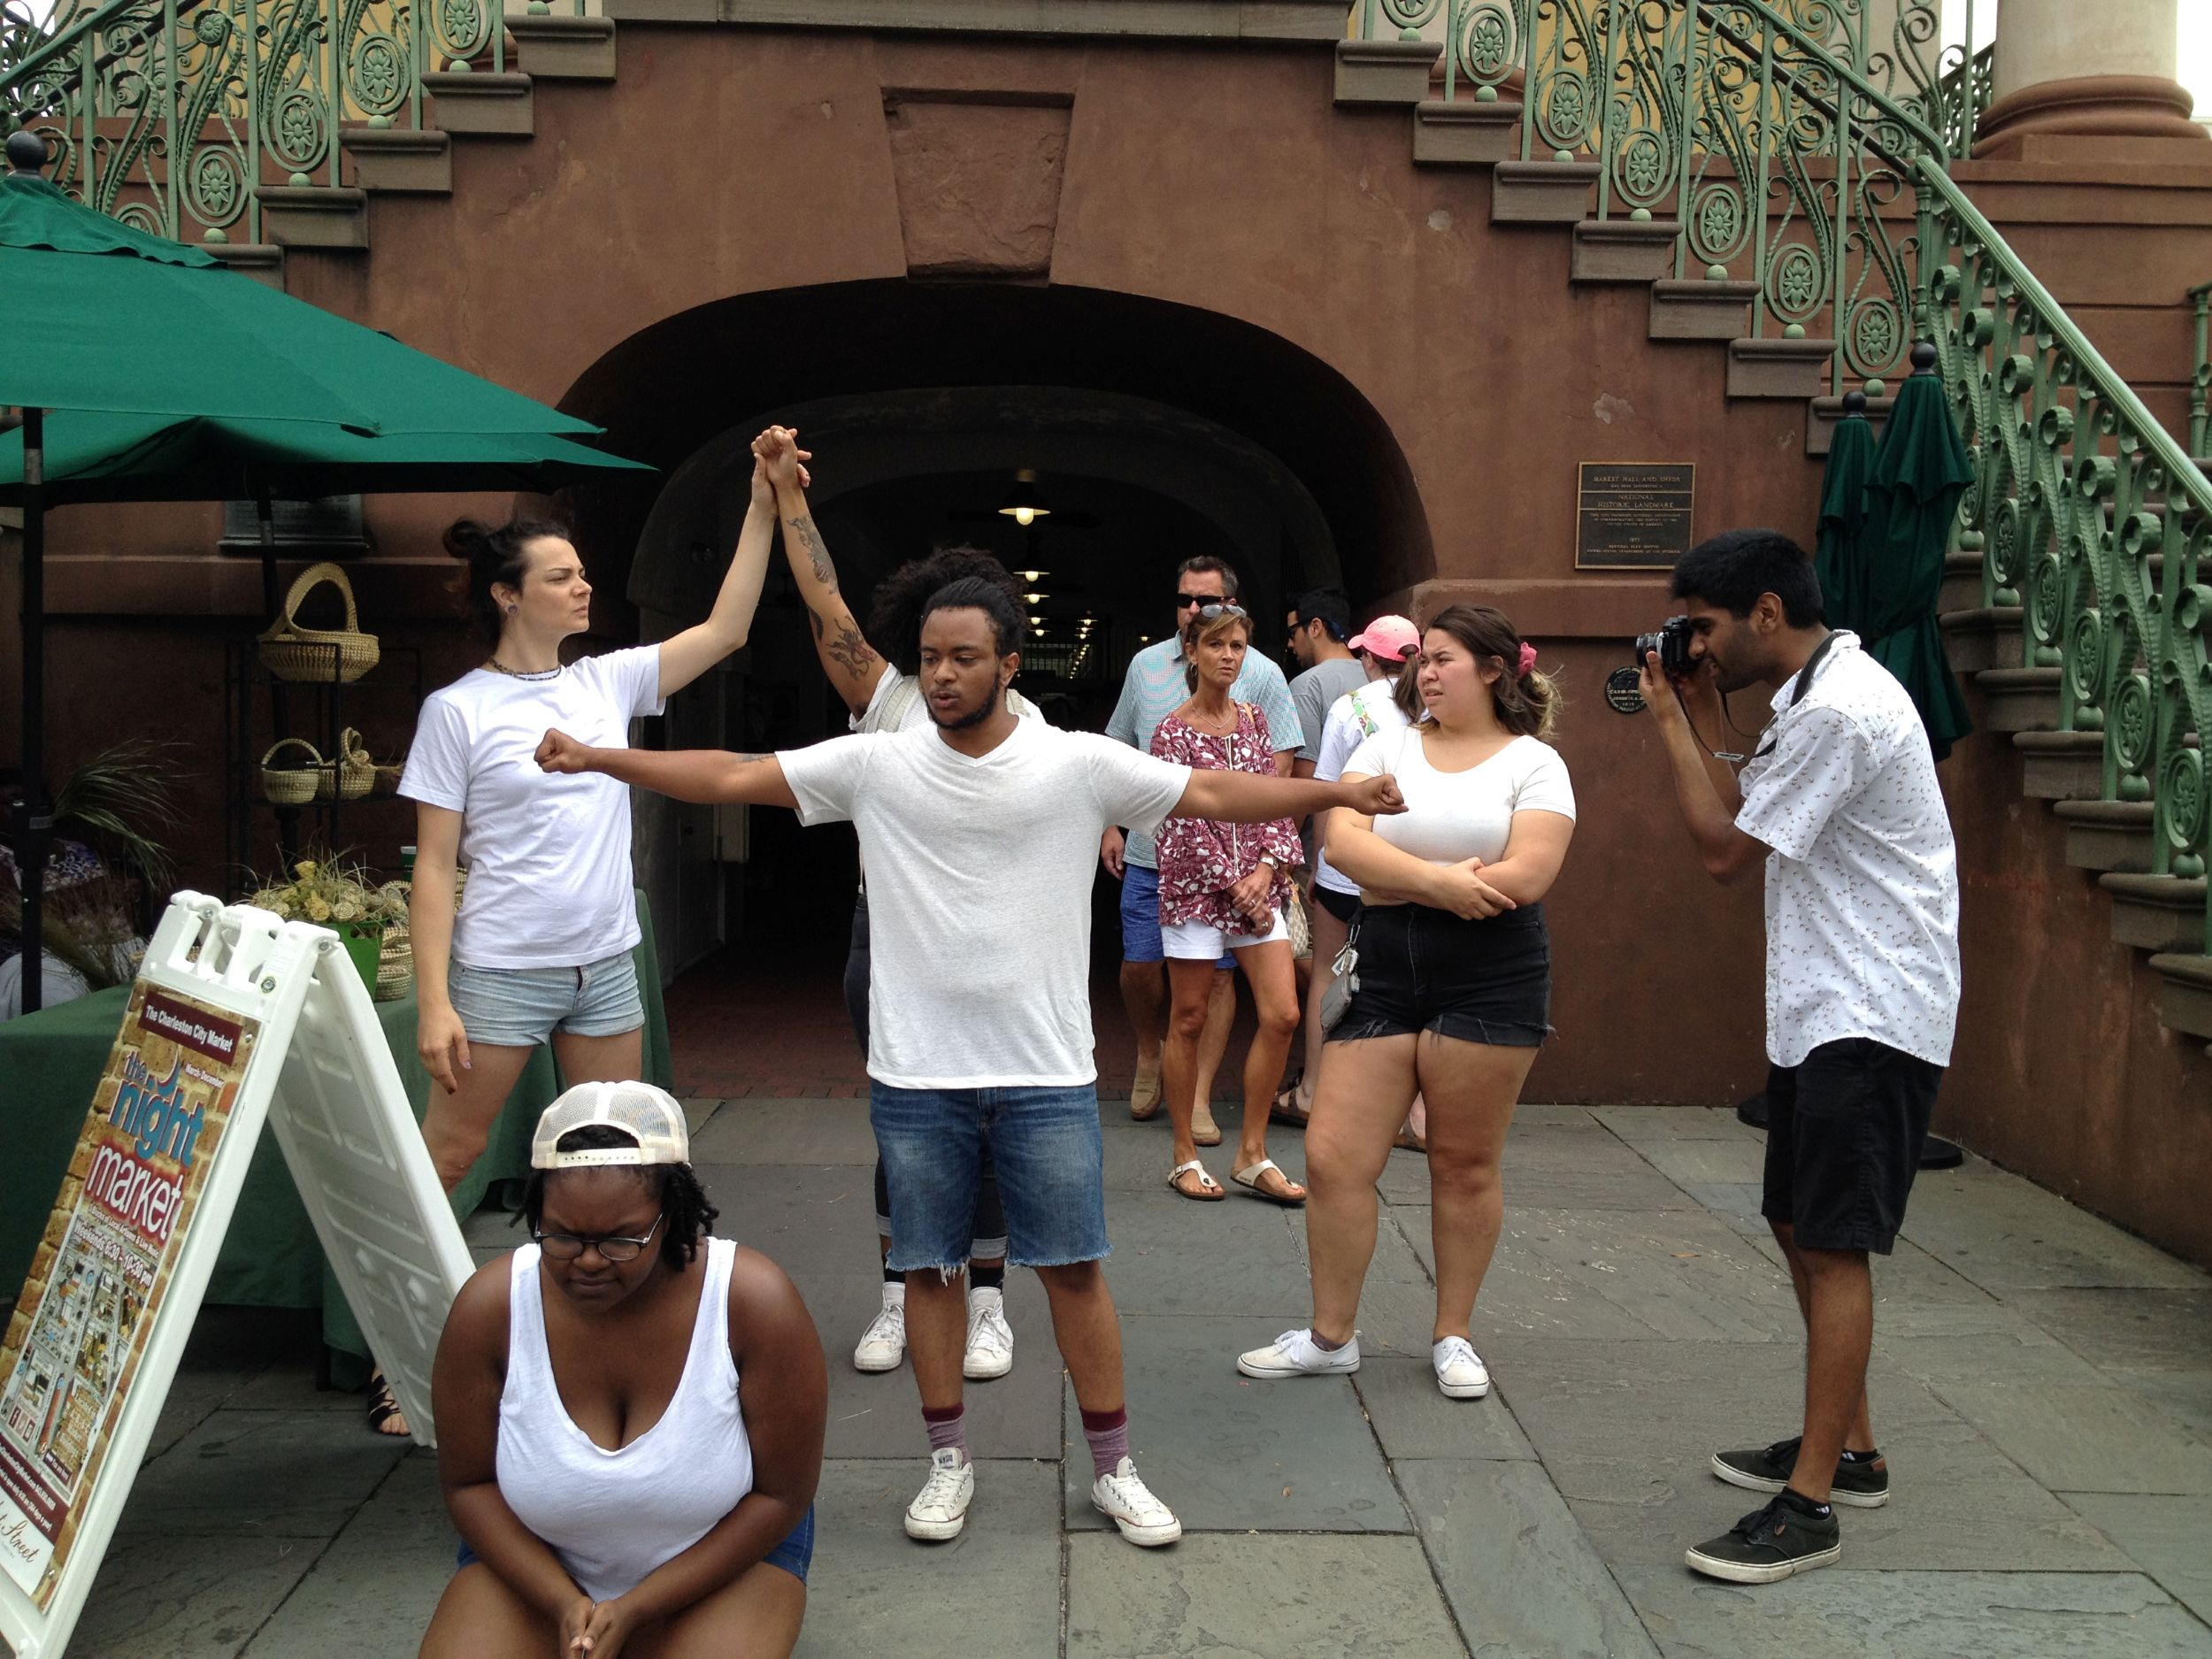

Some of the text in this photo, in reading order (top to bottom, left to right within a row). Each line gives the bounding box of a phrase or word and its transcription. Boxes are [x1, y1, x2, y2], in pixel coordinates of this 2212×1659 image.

[146, 1005, 234, 1052] The Charleston City Market
[124, 1050, 148, 1083] the
[107, 1076, 205, 1167] night
[87, 1145, 184, 1240] market
[74, 1219, 105, 1251] Weekends
[104, 1240, 120, 1261] 6:30
[140, 1269, 152, 1286] pm
[138, 1237, 150, 1250] Live
[1, 1520, 40, 1563] Street
